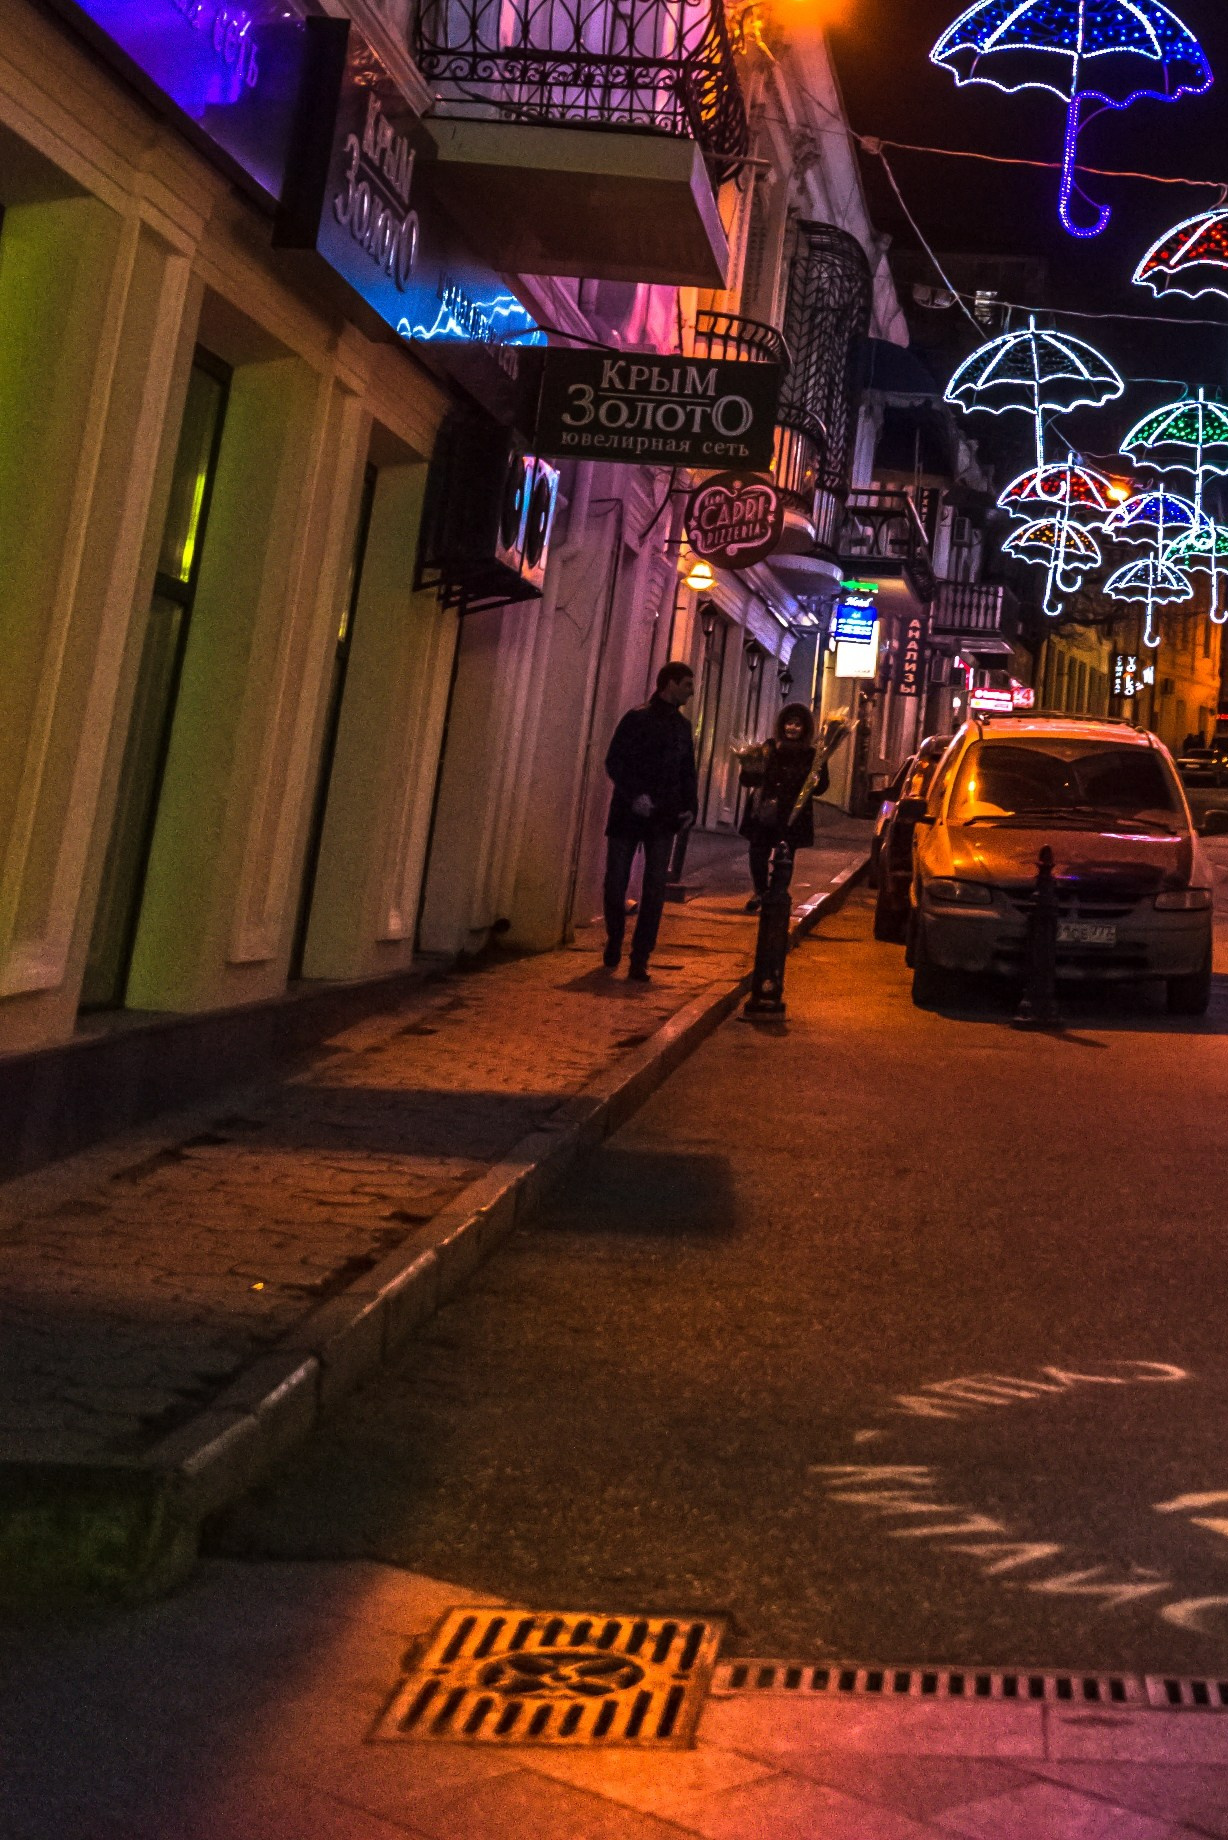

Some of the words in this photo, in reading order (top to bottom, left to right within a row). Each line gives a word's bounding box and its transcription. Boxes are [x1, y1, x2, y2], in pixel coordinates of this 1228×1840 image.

[601, 359, 718, 396] КРЫМ
[561, 431, 692, 454] ювелирная
[702, 441, 750, 457] сеть
[701, 496, 766, 530] CAPRI
[900, 619, 920, 693] АНАЛИЗЫ
